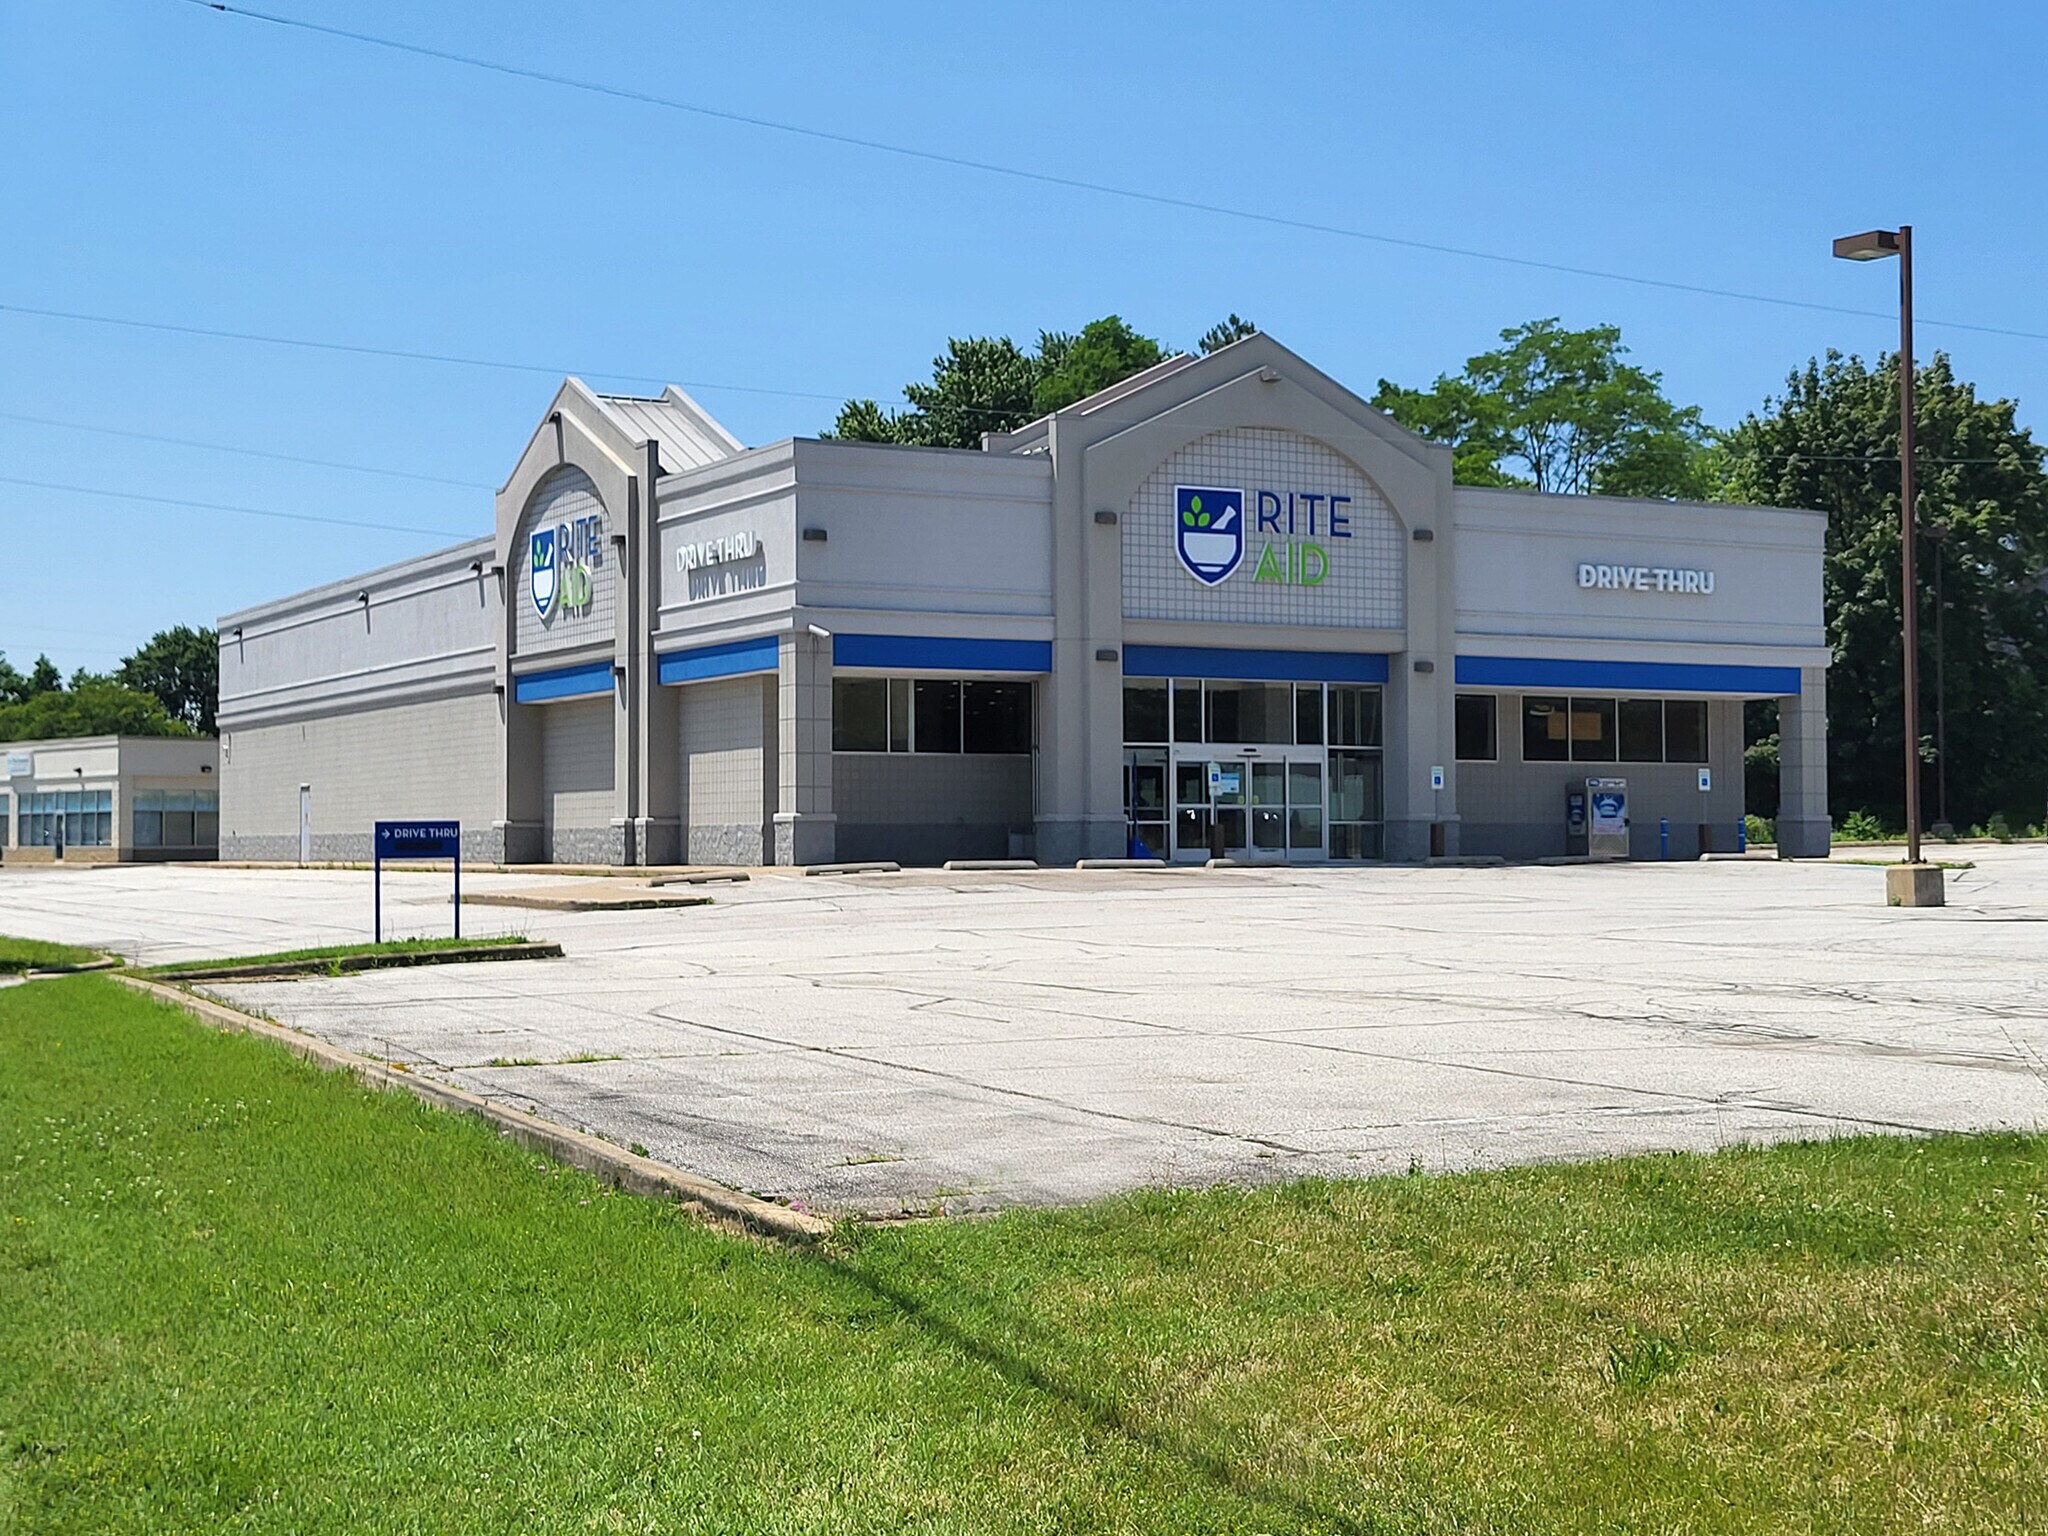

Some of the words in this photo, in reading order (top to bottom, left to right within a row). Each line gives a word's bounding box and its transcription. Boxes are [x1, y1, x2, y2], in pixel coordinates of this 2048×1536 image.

[1255, 490, 1352, 538] RITE
[559, 515, 599, 562] RITE
[676, 541, 714, 572] DRIVE
[715, 531, 755, 564] THRU
[1253, 541, 1329, 586] AID
[1578, 563, 1649, 591] DRIVE
[1652, 567, 1715, 595] THRU
[559, 564, 592, 608] AID
[394, 827, 427, 839] DRIVE
[428, 827, 459, 838] THRU
